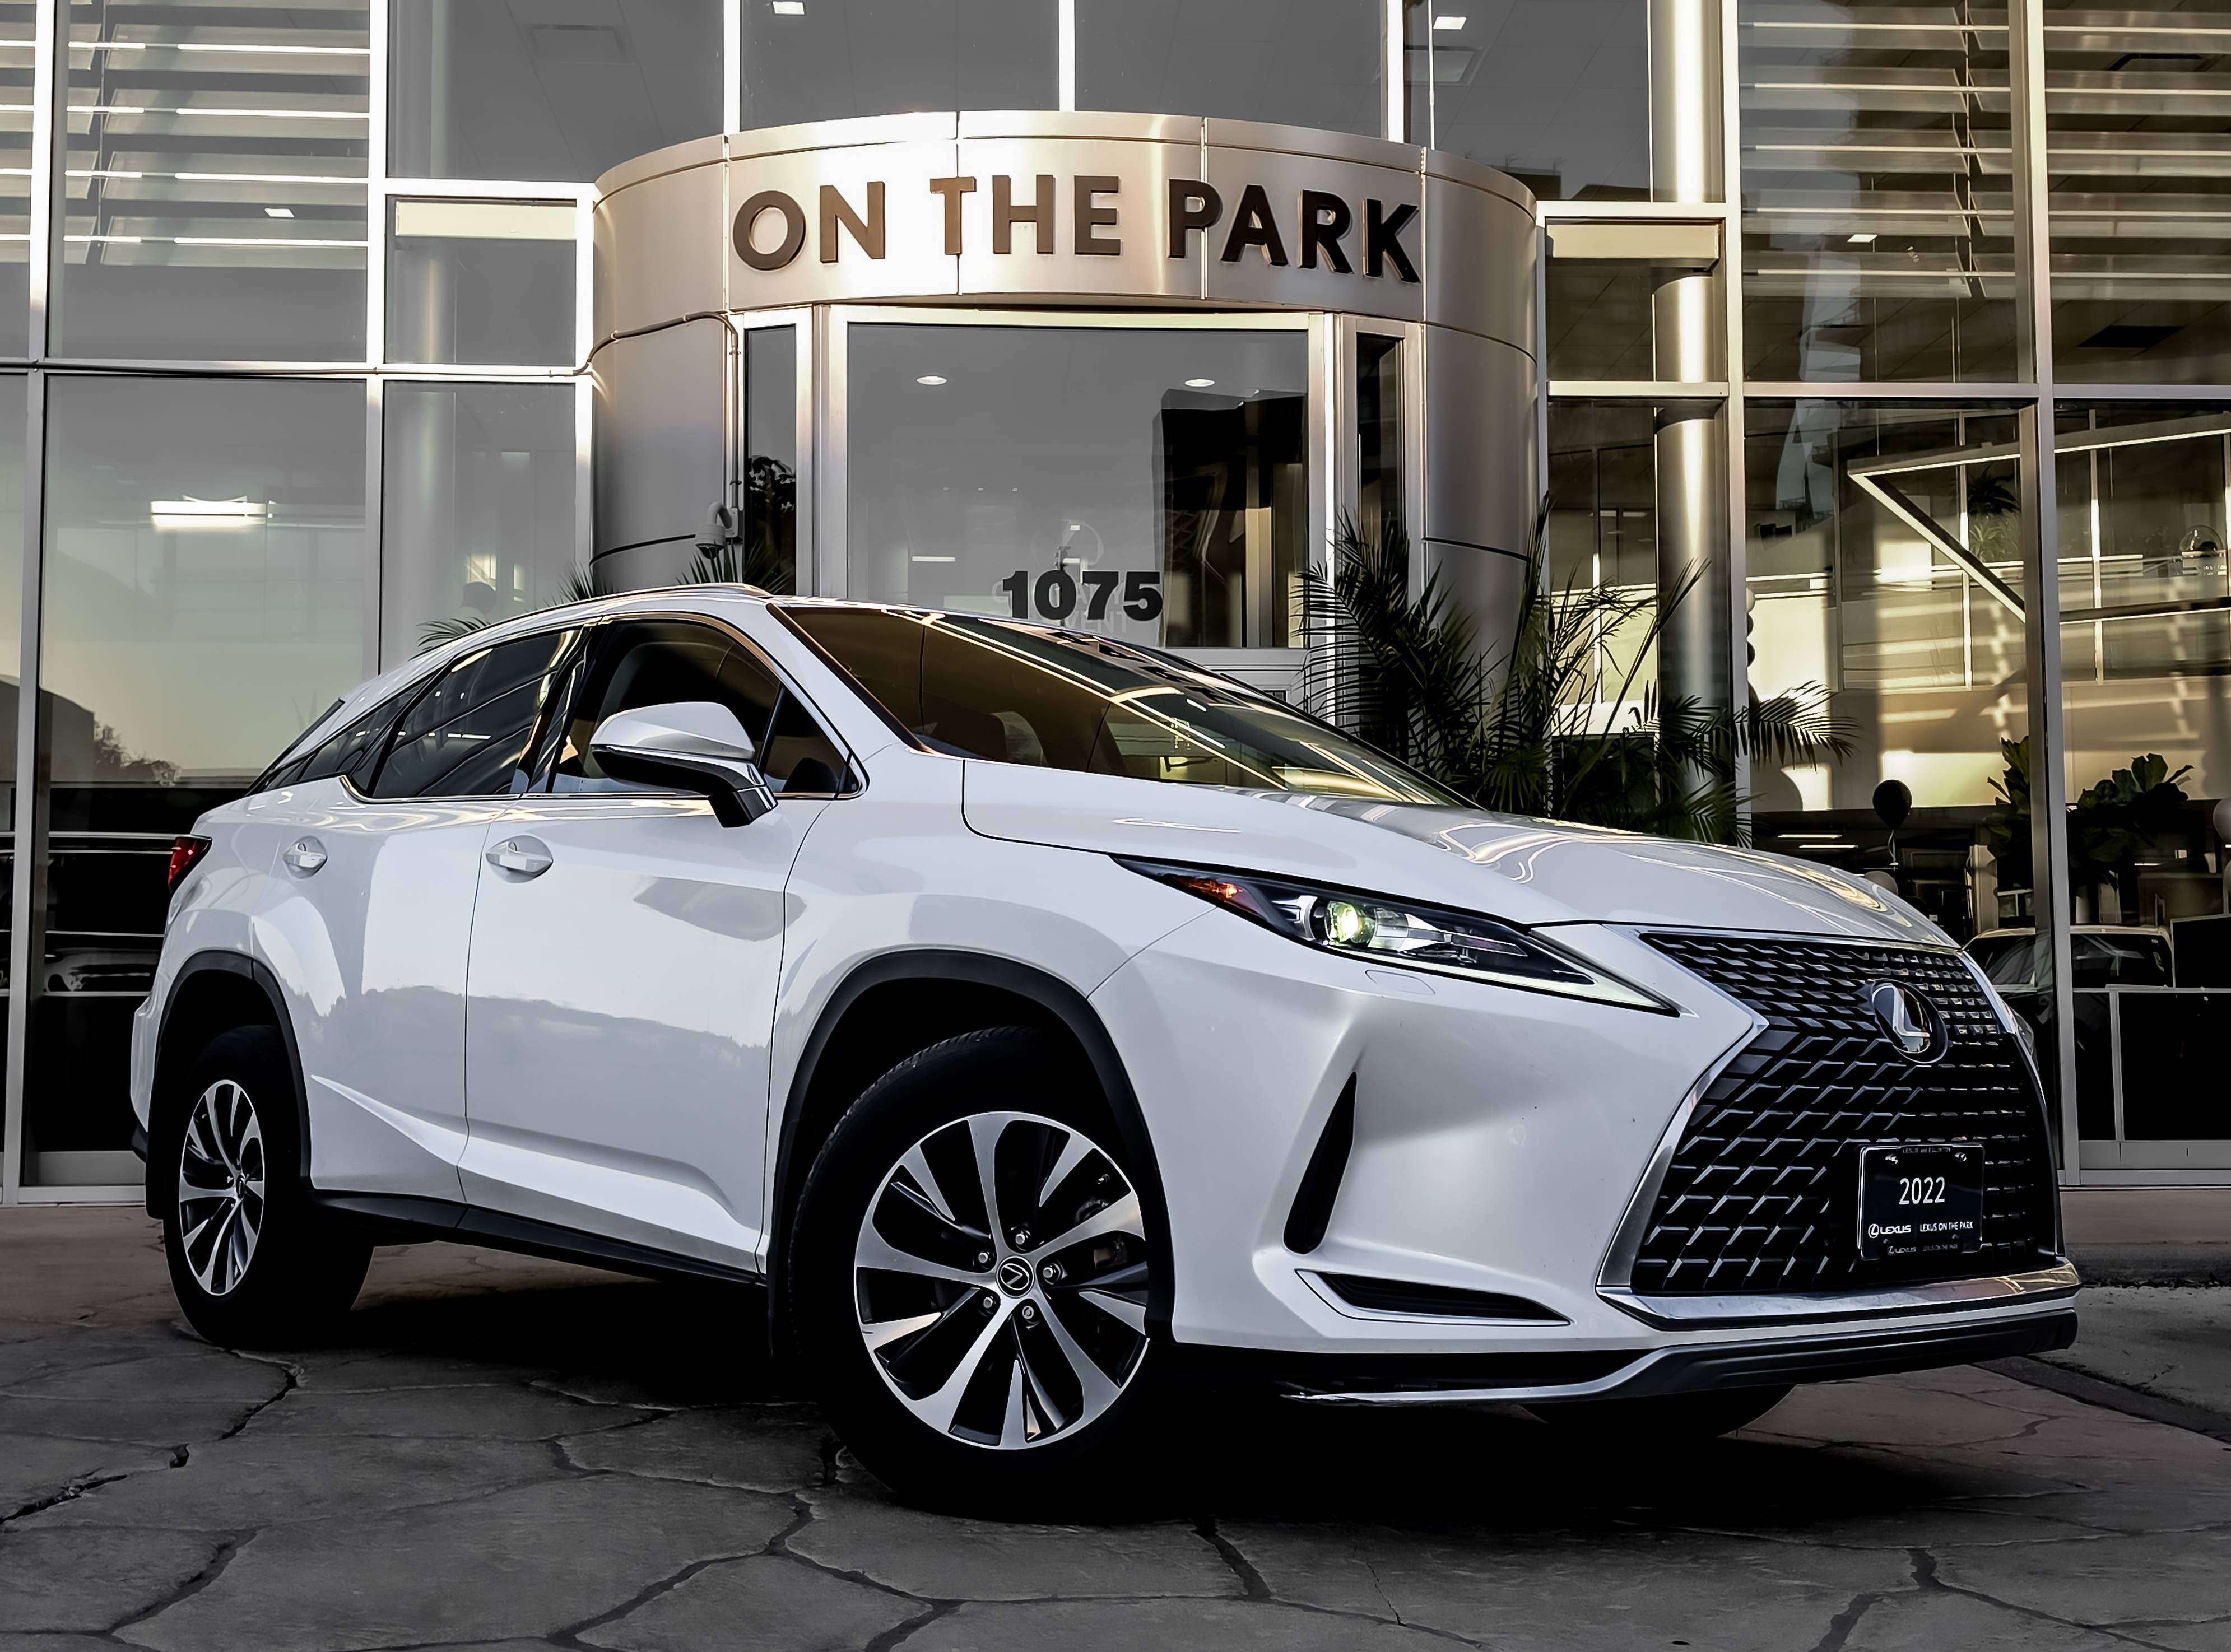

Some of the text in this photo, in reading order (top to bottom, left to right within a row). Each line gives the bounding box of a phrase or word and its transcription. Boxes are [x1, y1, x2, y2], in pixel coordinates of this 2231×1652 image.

[732, 174, 1422, 284] ON THE PARK
[1002, 570, 1163, 621] 1075
[1899, 1176, 1945, 1204] 2022
[1880, 1225, 1911, 1235] LEXUS
[1919, 1223, 1937, 1232] LEXUS
[1938, 1222, 1947, 1231] ON
[1949, 1222, 1958, 1230] THE
